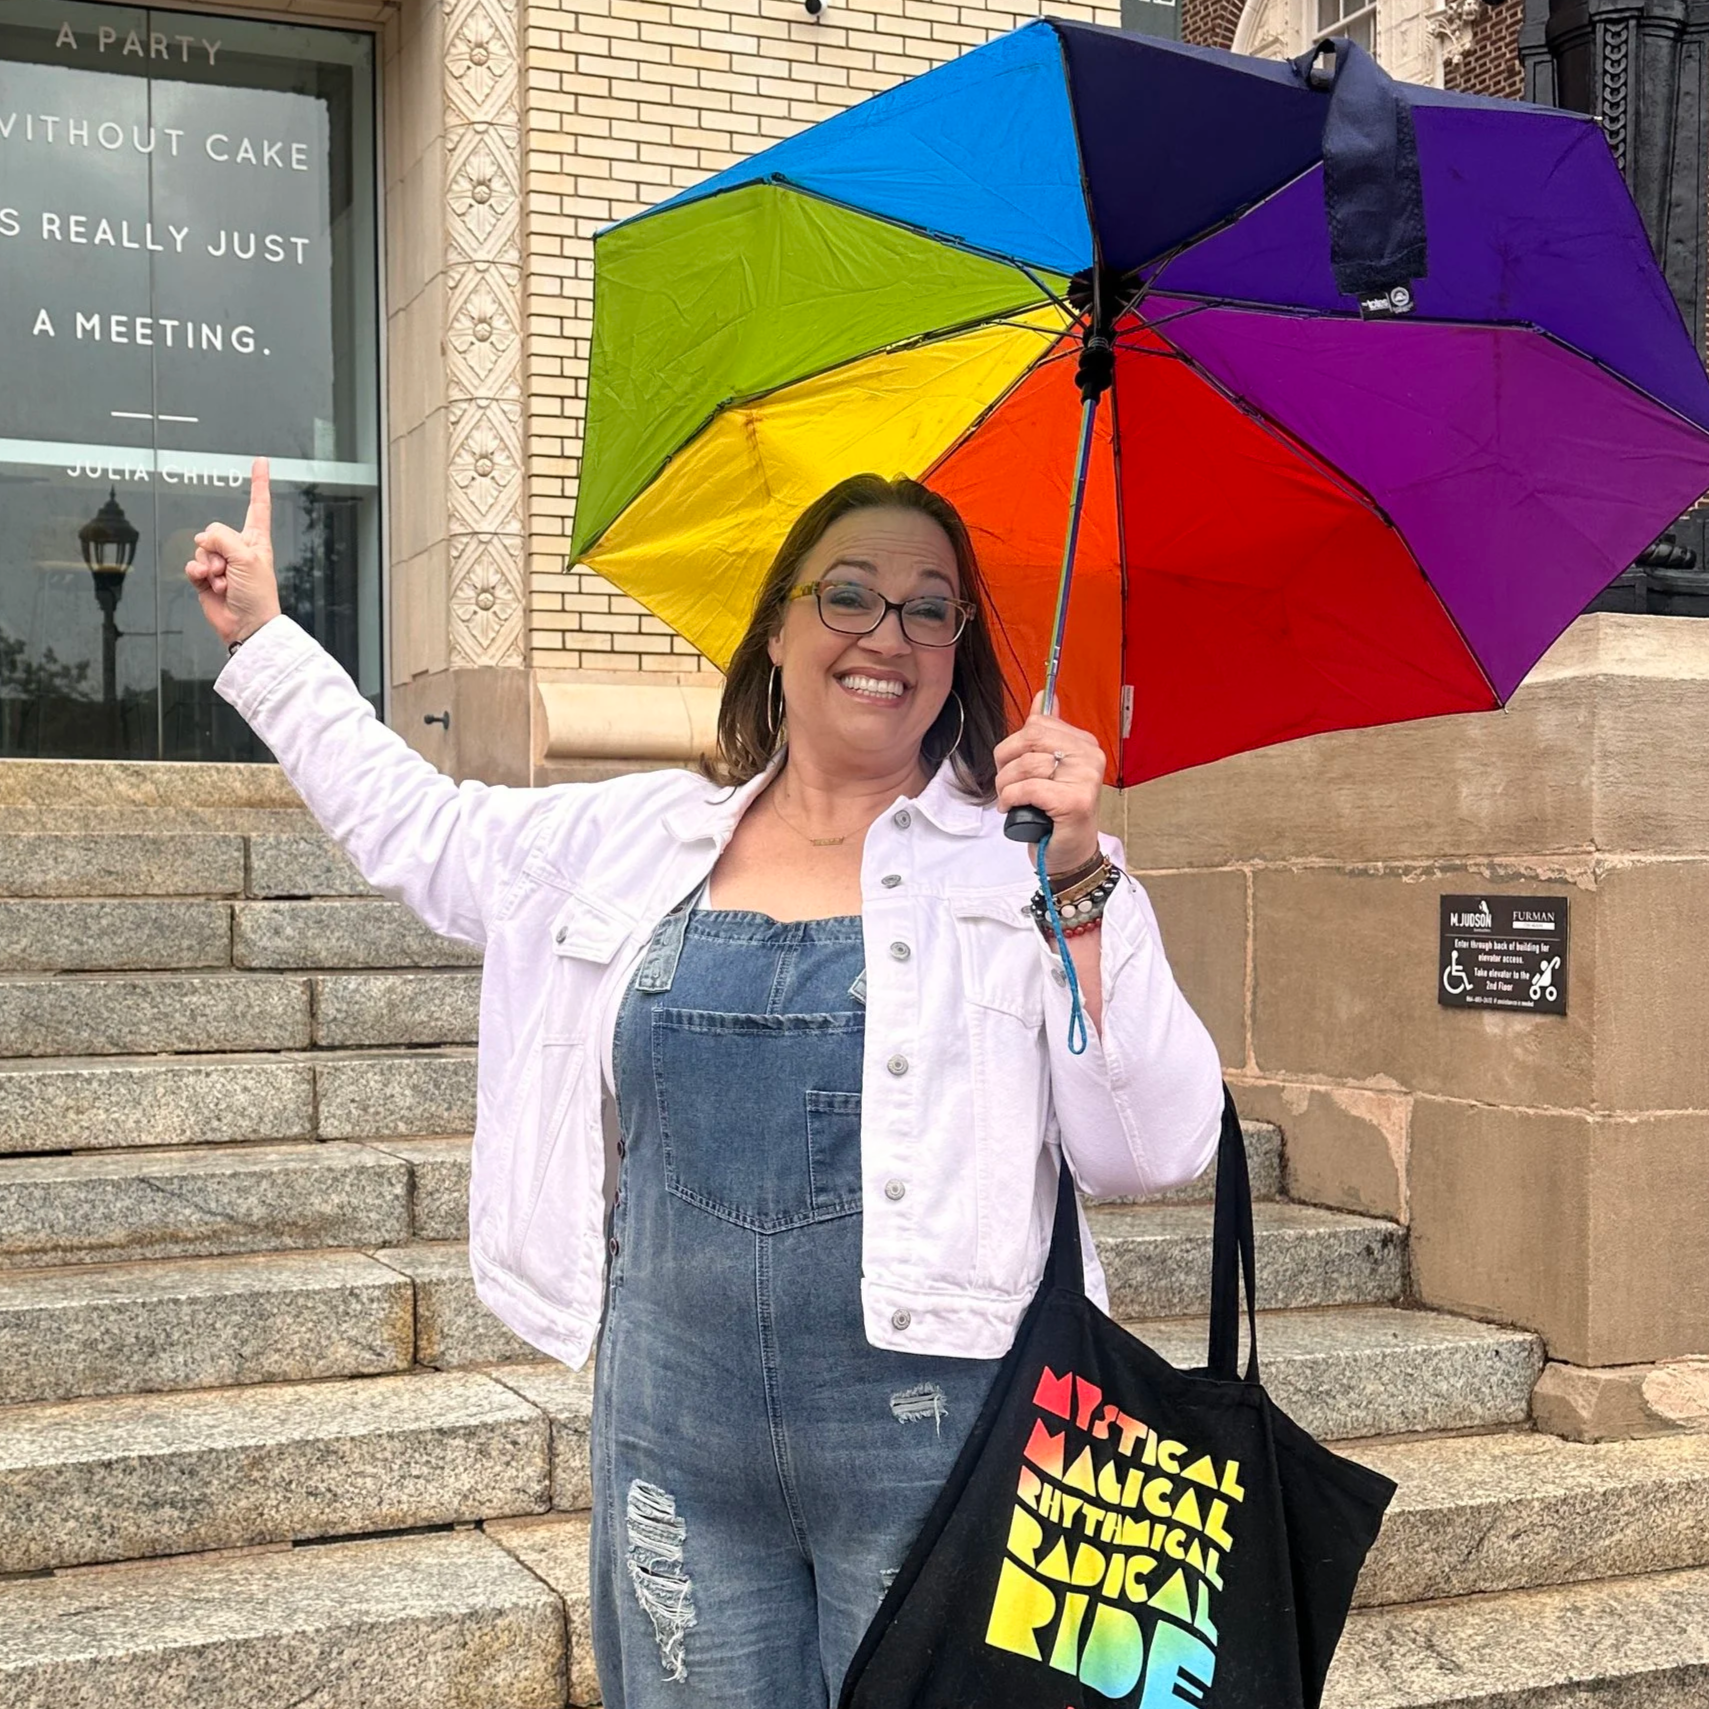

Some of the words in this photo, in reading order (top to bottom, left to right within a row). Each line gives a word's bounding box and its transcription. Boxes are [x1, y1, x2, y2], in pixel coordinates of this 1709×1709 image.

[56, 22, 77, 49] A
[99, 26, 223, 65] PARTY
[206, 133, 309, 170] CAKE
[42, 212, 189, 252] REALLY
[207, 230, 310, 264] JUST
[33, 309, 55, 337] A
[76, 312, 271, 355] MEETING.
[67, 460, 149, 482] JULIA
[161, 464, 243, 487] CHILD
[1450, 912, 1492, 928] M.JUDSON
[1512, 911, 1555, 921] FURMAN
[1454, 938, 1469, 948] Enter
[1470, 940, 1492, 951] through
[1494, 940, 1507, 950] back
[1509, 941, 1515, 951] of
[1516, 941, 1539, 954] building
[1541, 943, 1550, 953] for
[1478, 953, 1501, 963] elevator
[1474, 967, 1488, 977] Take
[1489, 968, 1512, 979] elevator
[1513, 970, 1519, 979] to
[1520, 970, 1530, 980] the
[1486, 980, 1497, 991] 2nd
[1498, 981, 1513, 992] Floor
[1032, 1365, 1245, 1502] MYSTICAL
[1023, 1417, 1234, 1552] MAGICAL
[1016, 1464, 1224, 1592] RHYTHMICAL
[1006, 1504, 1218, 1647] RADICAL
[984, 1556, 1216, 1709] RIDE
